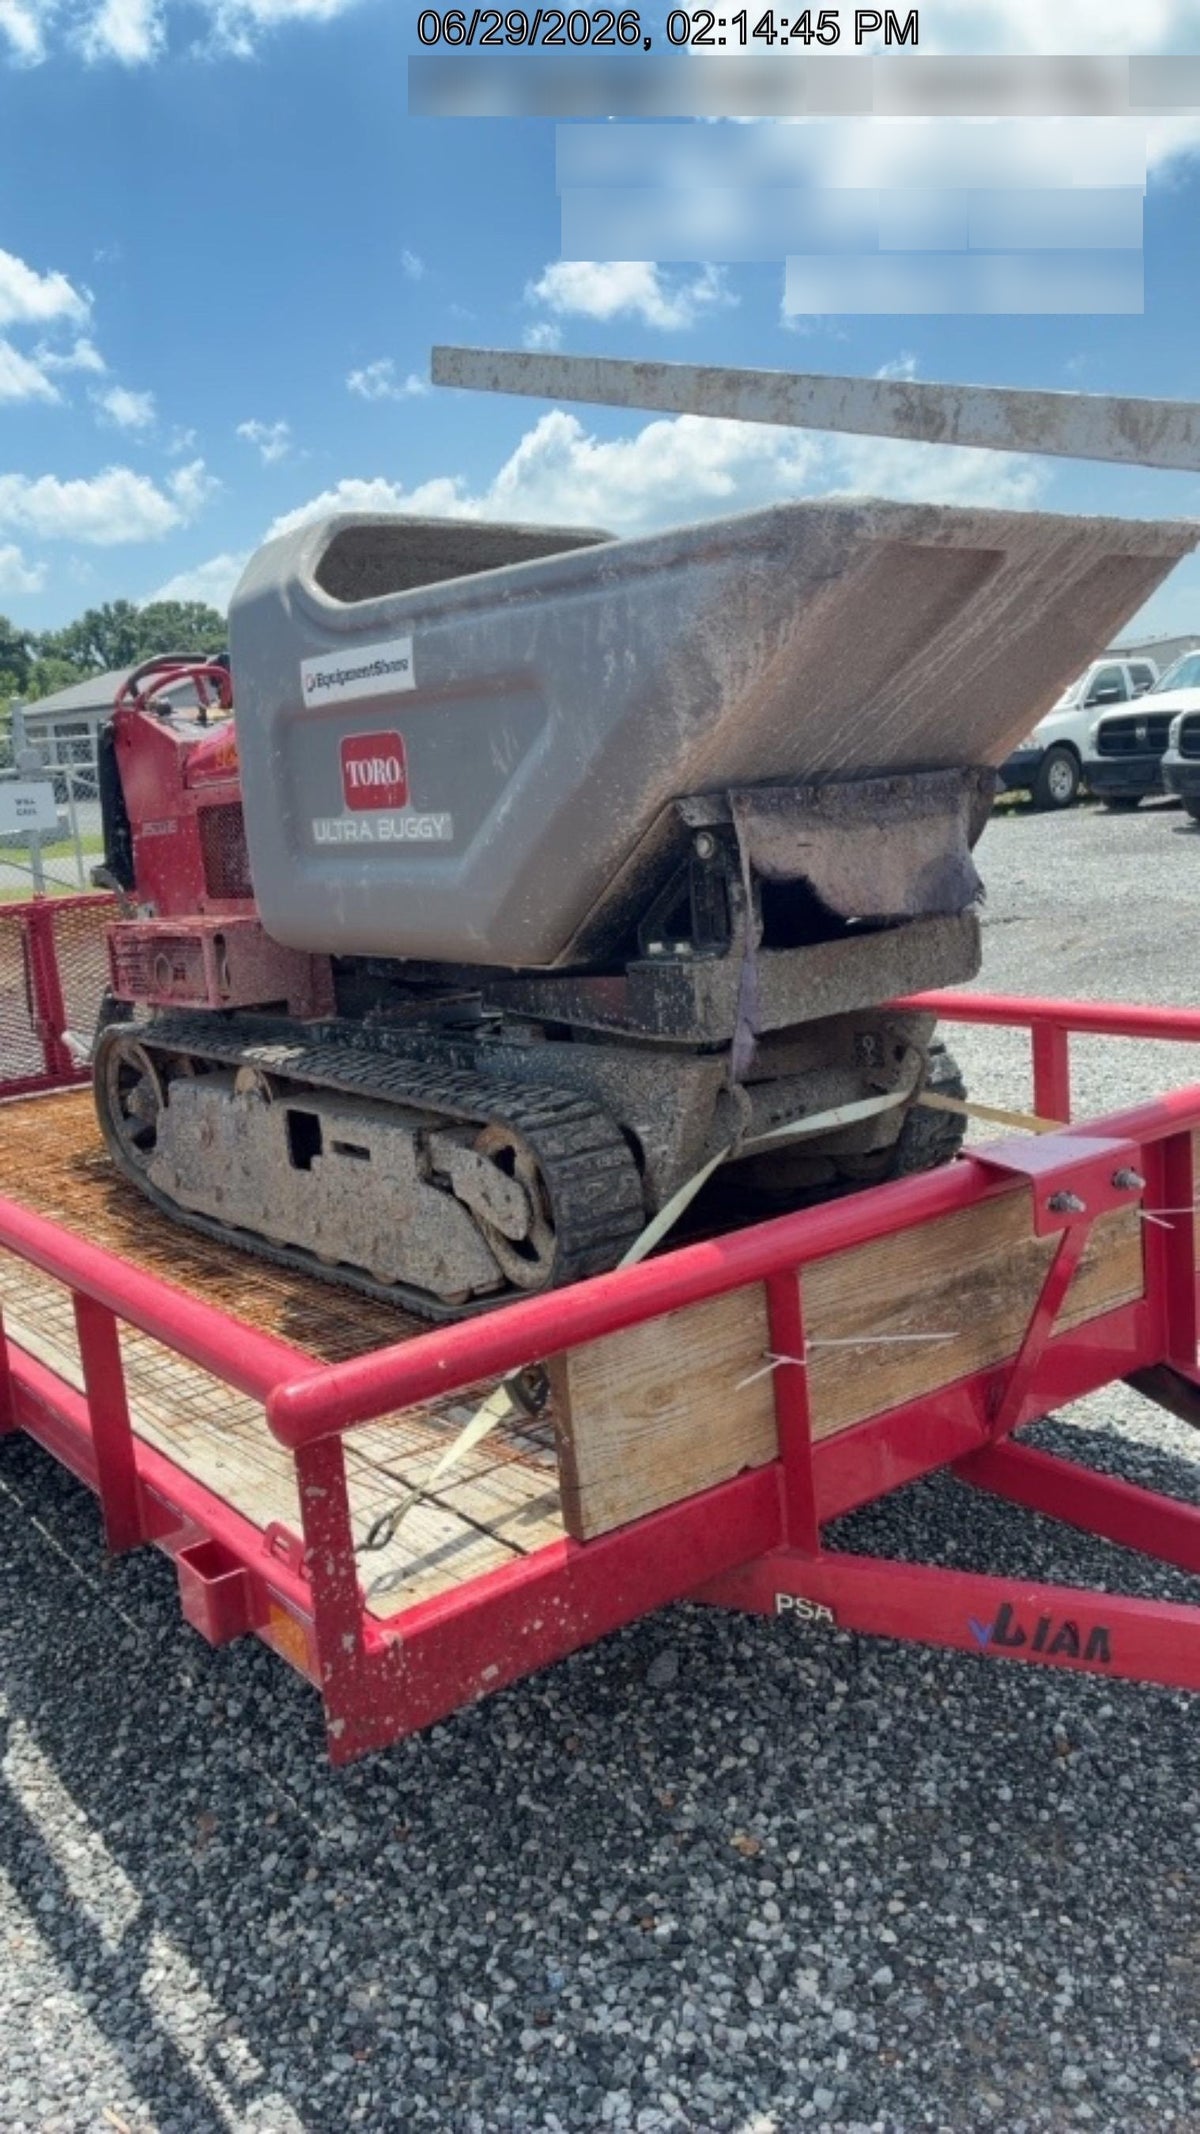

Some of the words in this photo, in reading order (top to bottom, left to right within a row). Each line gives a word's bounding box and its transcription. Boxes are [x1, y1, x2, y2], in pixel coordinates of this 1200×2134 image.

[346, 756, 402, 788] TORO
[314, 820, 372, 841] ULTRA
[378, 816, 447, 839] BUGGY
